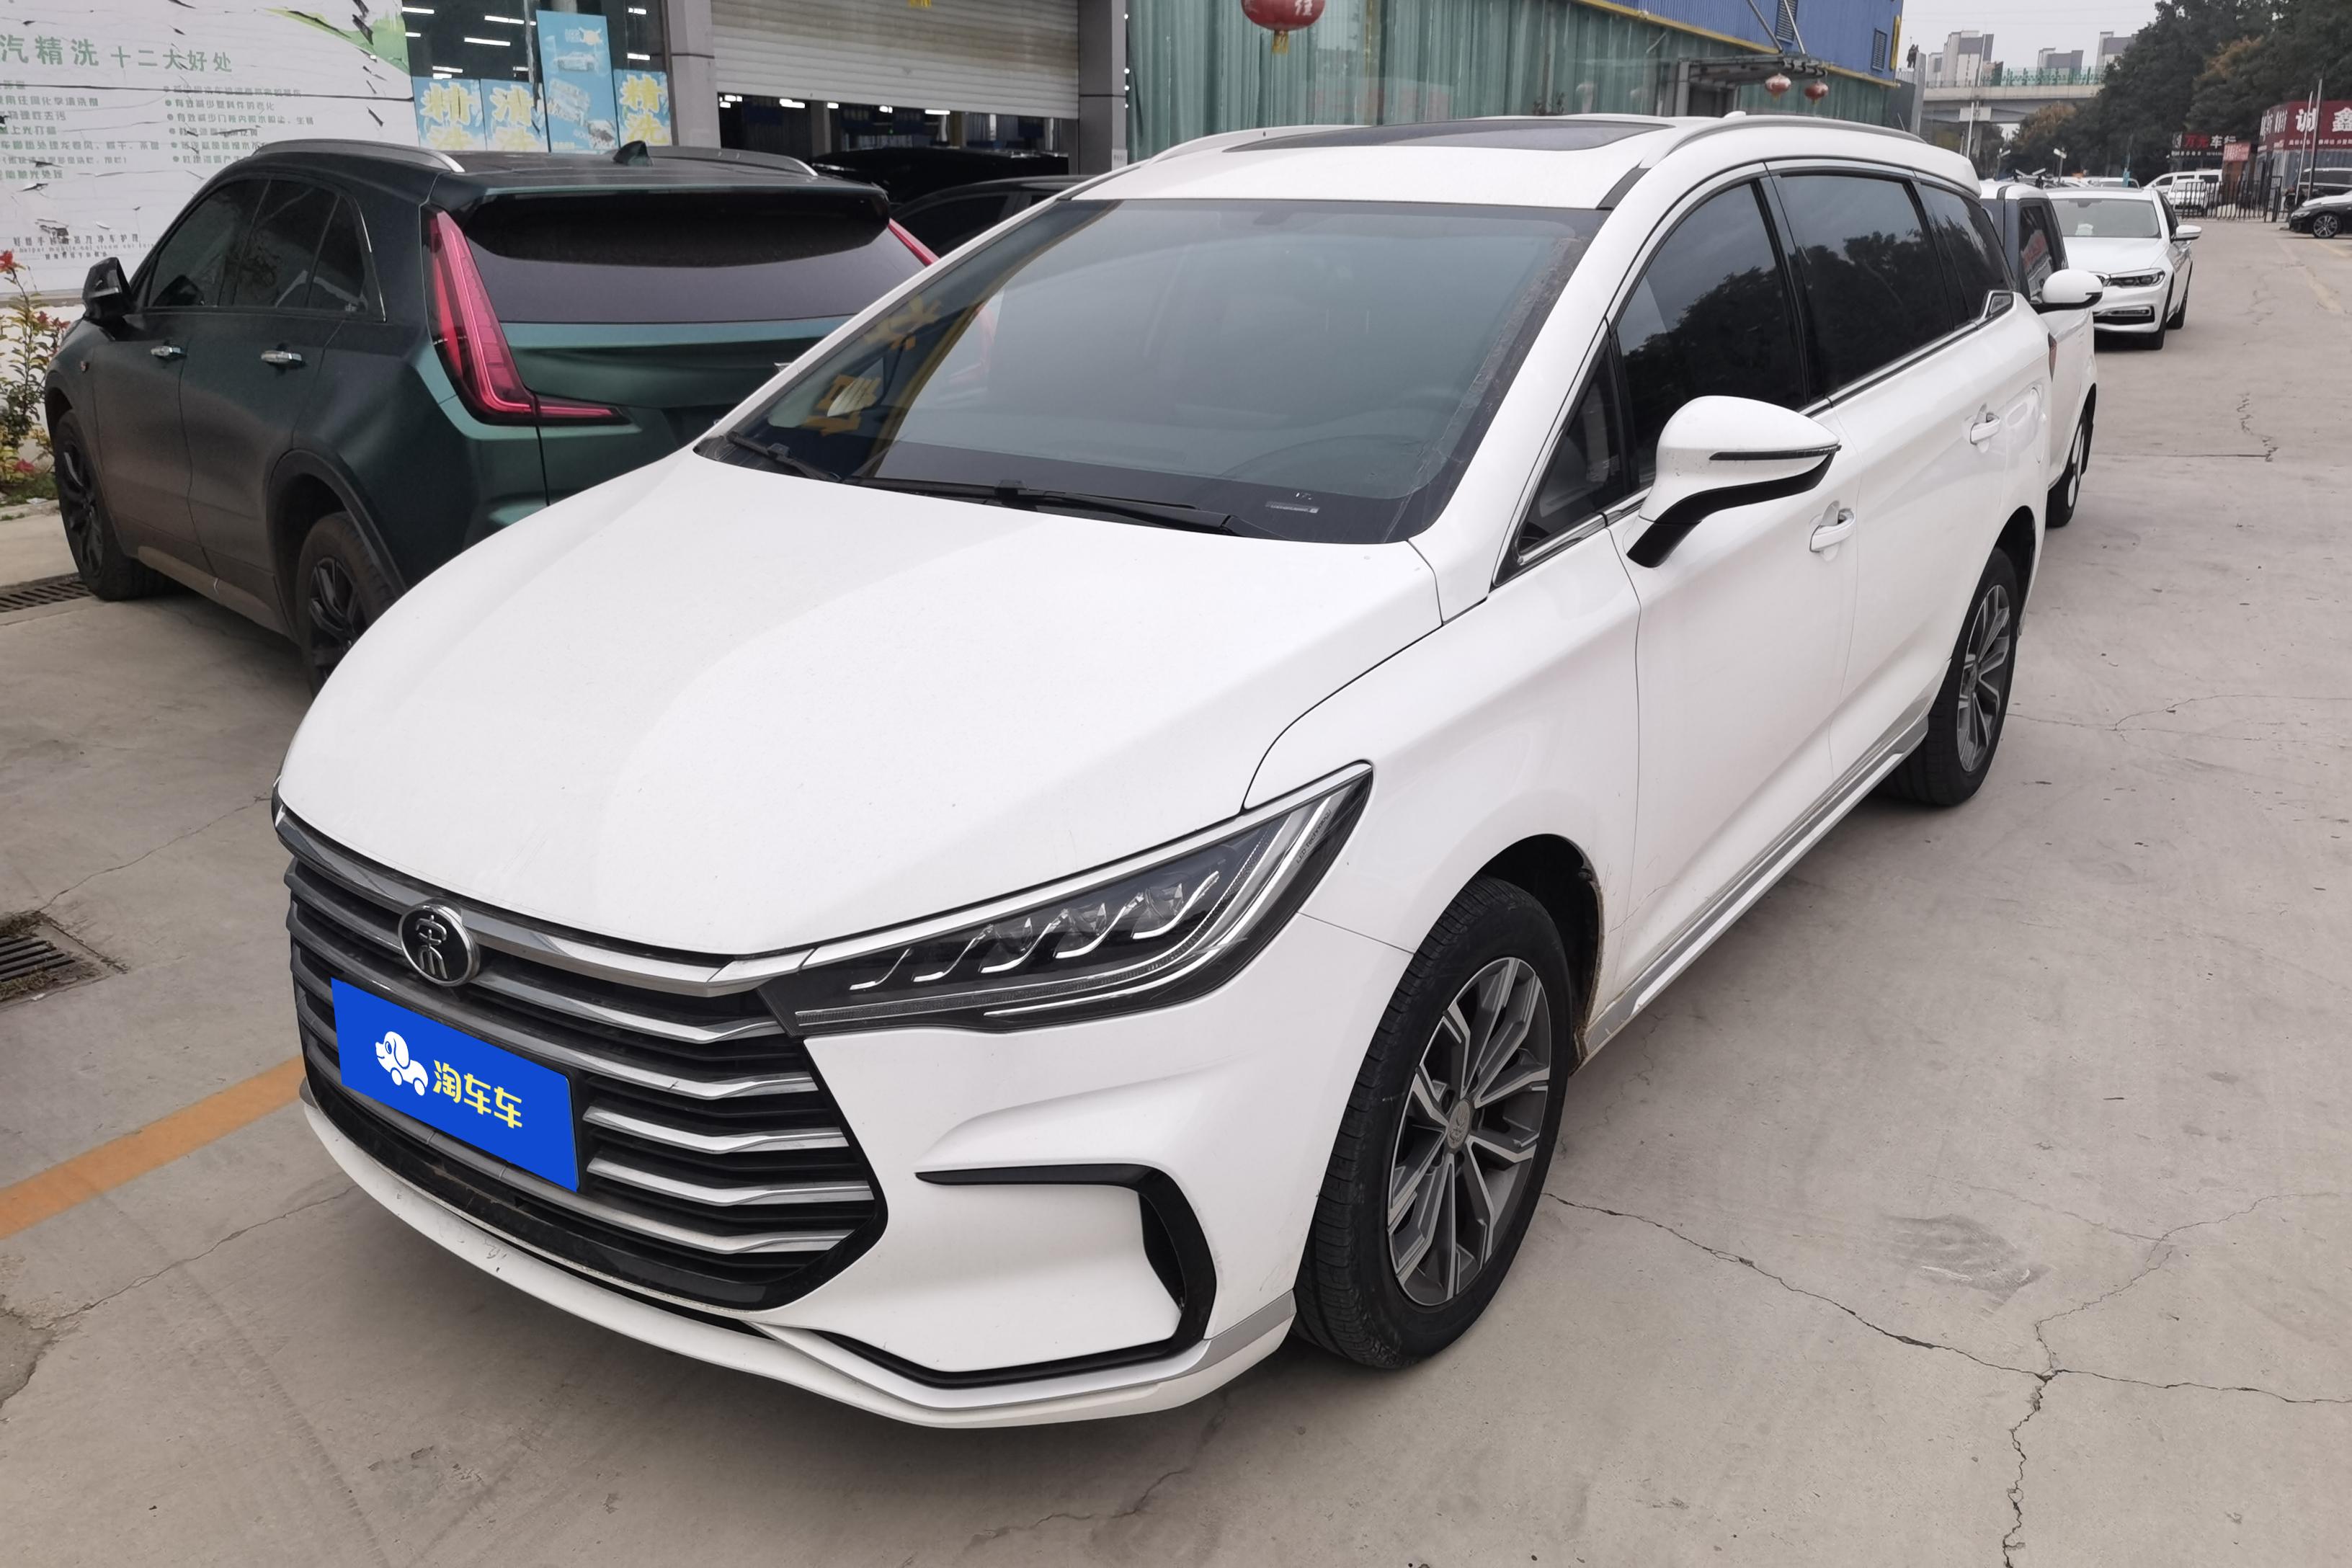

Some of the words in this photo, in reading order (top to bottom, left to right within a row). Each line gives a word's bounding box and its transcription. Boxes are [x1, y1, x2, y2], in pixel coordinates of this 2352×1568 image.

[111, 46, 233, 73] 十二大好处
[1296, 848, 1307, 864] LED
